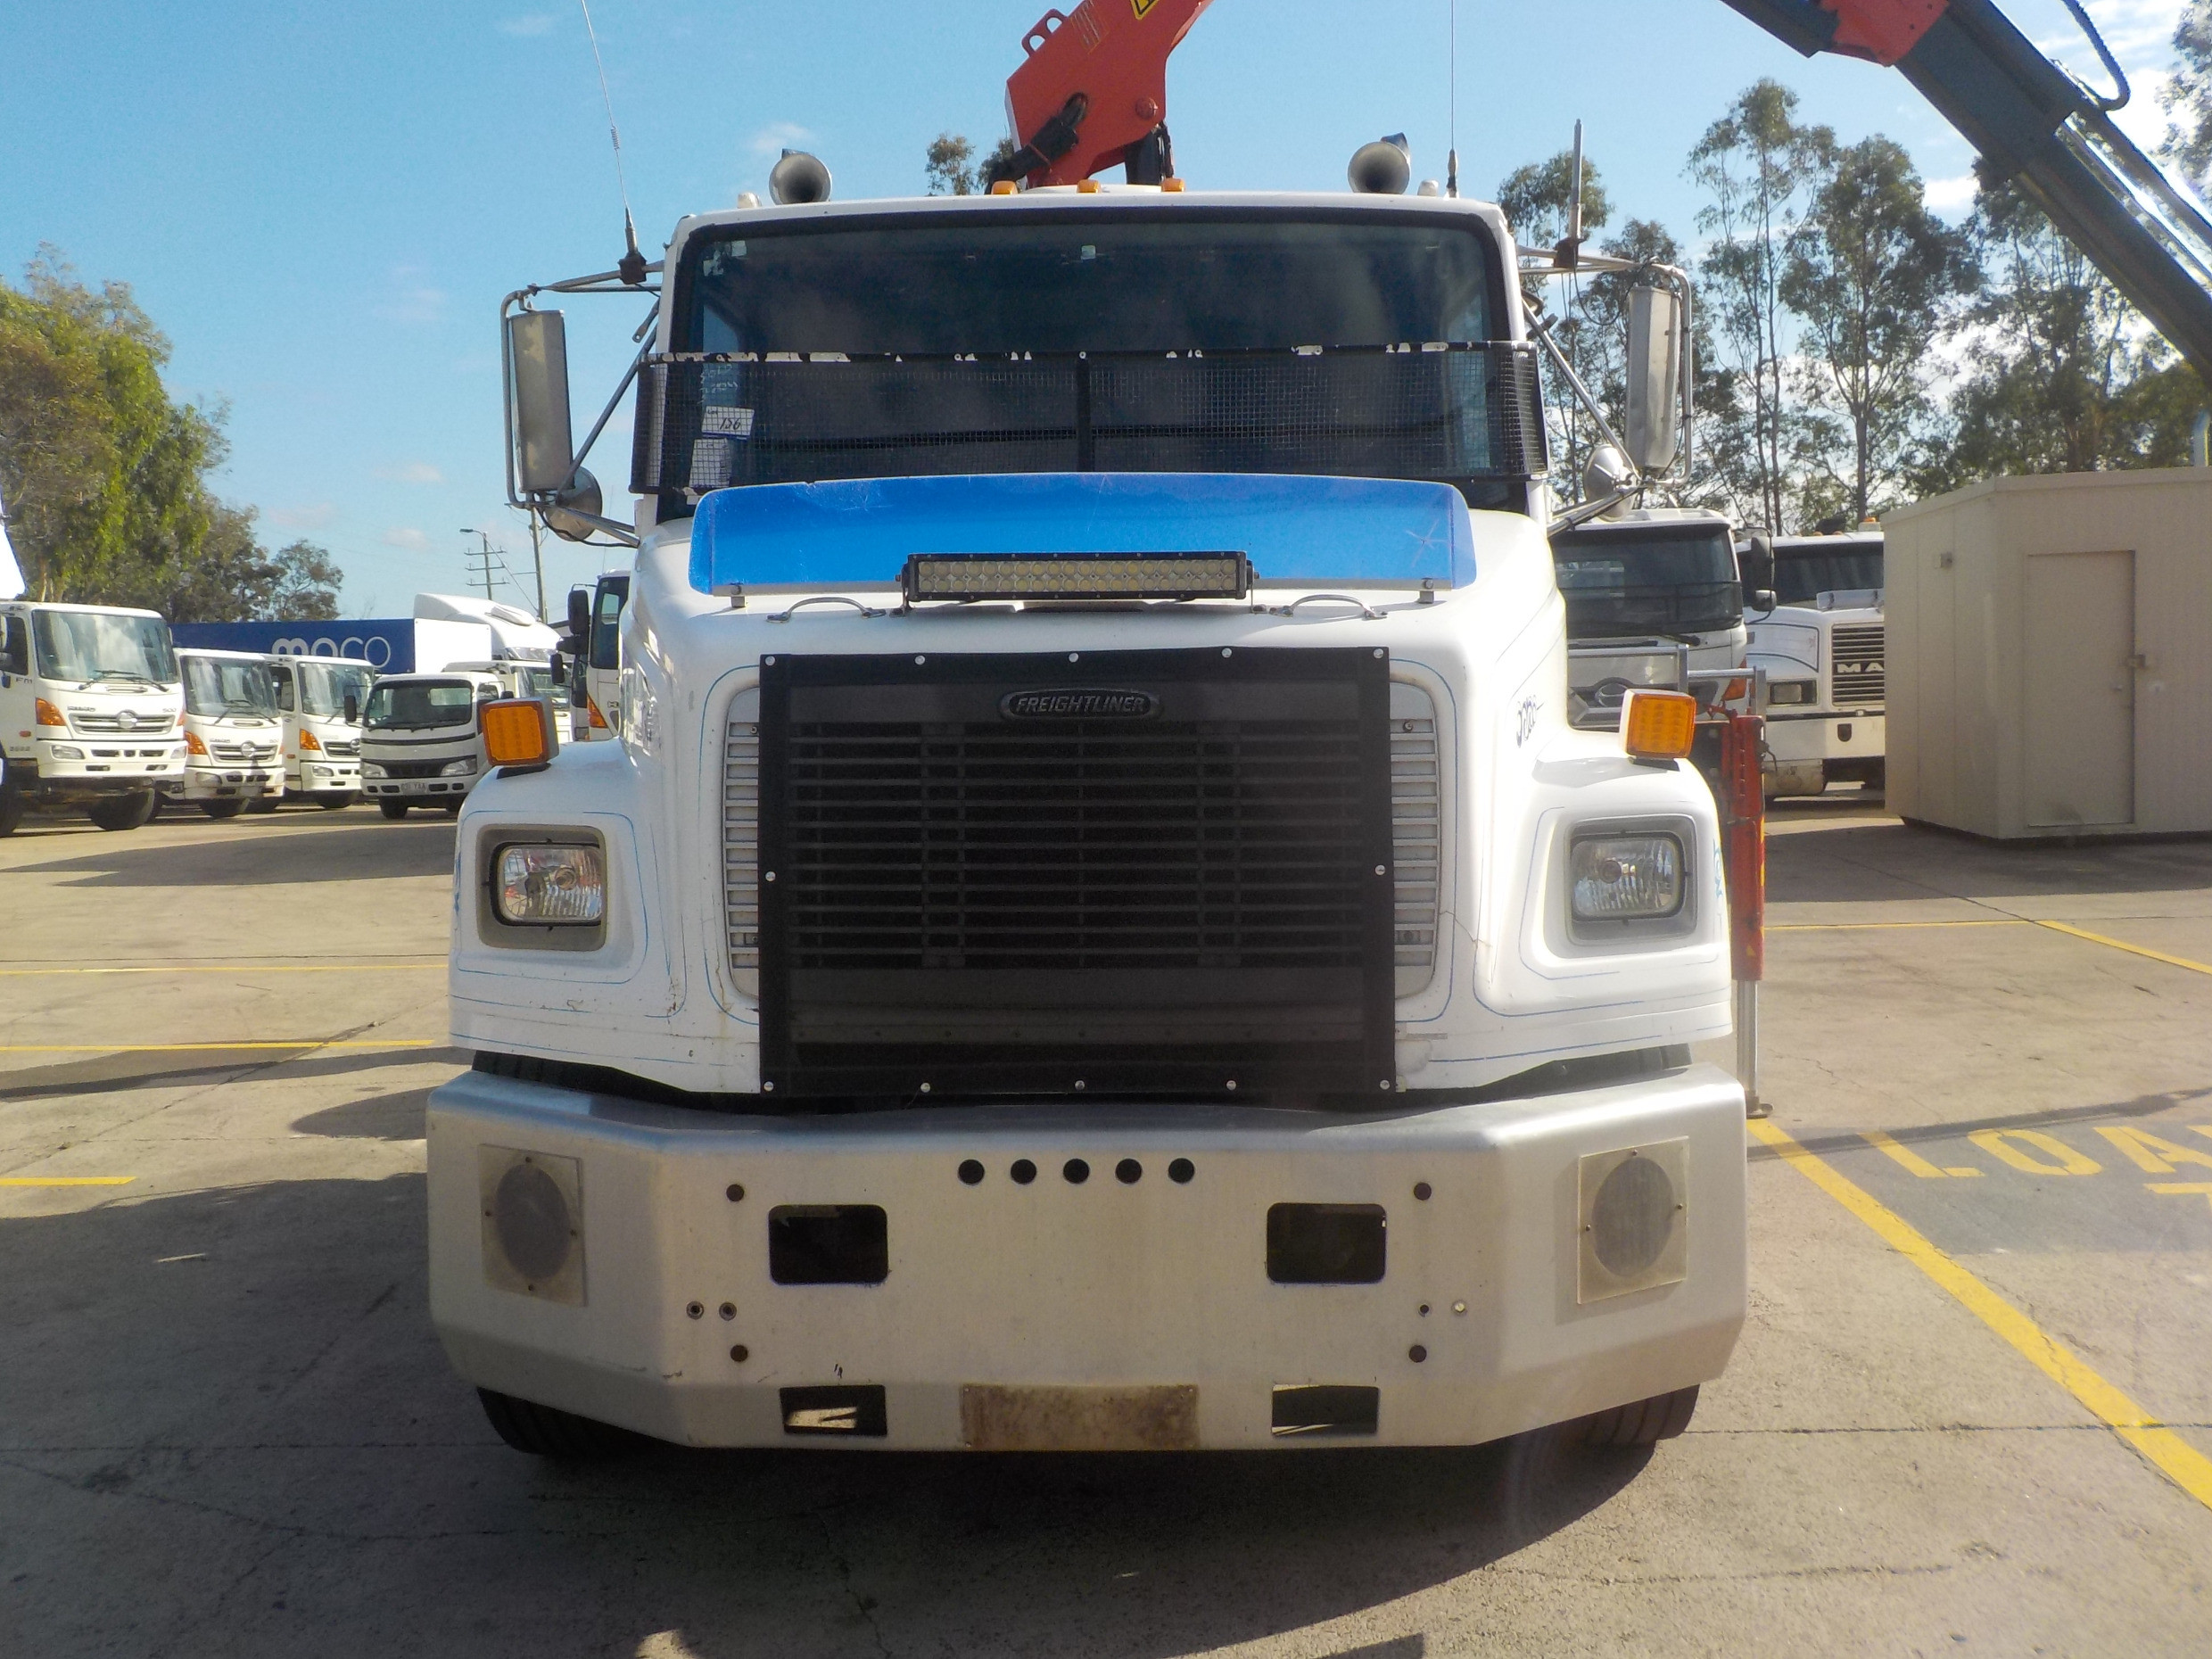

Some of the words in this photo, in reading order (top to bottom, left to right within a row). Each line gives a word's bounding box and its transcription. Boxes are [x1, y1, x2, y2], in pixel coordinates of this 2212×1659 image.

[1836, 662, 1885, 673] MA
[1016, 695, 1145, 713] FREIGHTLINER
[1857, 1126, 2212, 1177] LOA
